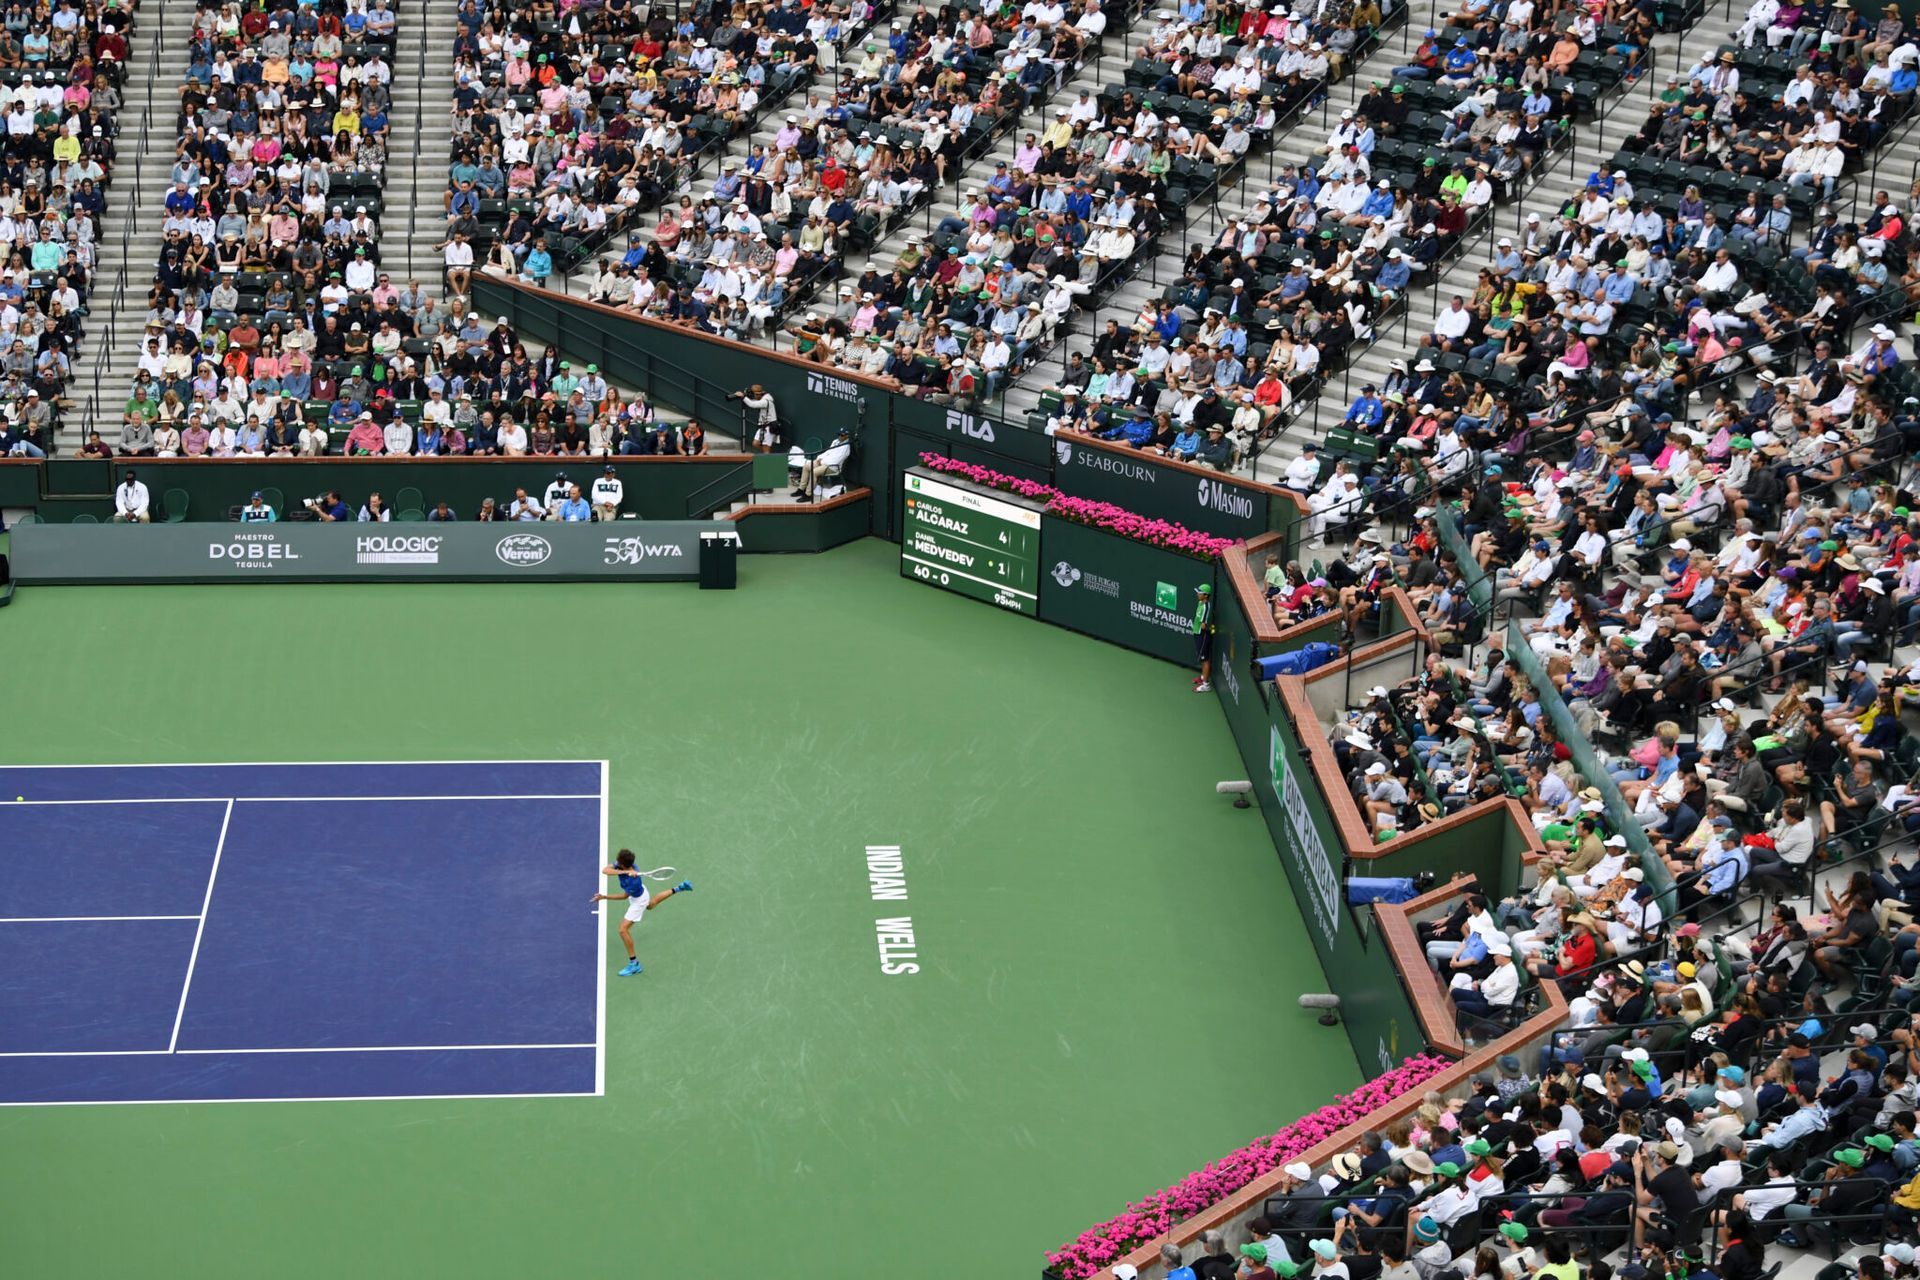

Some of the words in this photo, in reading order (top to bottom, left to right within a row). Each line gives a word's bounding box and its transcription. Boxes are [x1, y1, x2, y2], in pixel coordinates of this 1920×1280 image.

[824, 376, 857, 396] TENNIS
[824, 389, 857, 404] CHANNEL
[946, 409, 995, 443] FILA
[1078, 451, 1155, 483] SEABOURN
[916, 501, 942, 515] CARLOS
[962, 495, 981, 507] FINAL
[916, 510, 968, 534] ALCARAZ
[357, 536, 439, 552] HOLOGIC
[706, 539, 711, 547] 1
[723, 538, 730, 547] 2
[998, 531, 1008, 544] 4
[209, 543, 299, 559] DOBEL
[501, 546, 543, 560] Veroni
[644, 544, 683, 557] WTA
[915, 540, 974, 567] MEDVEDEV
[914, 564, 930, 579] 40
[940, 573, 949, 585] 0
[998, 563, 1005, 575] 1
[1130, 601, 1153, 615] BNP
[1155, 608, 1194, 628] PARIBA
[1130, 610, 1139, 619] The
[1164, 621, 1185, 634] changing
[1285, 768, 1302, 826] BNP
[1303, 810, 1336, 917] PARIBAS
[865, 845, 908, 900] INDIAN
[875, 916, 920, 975] WELLS
